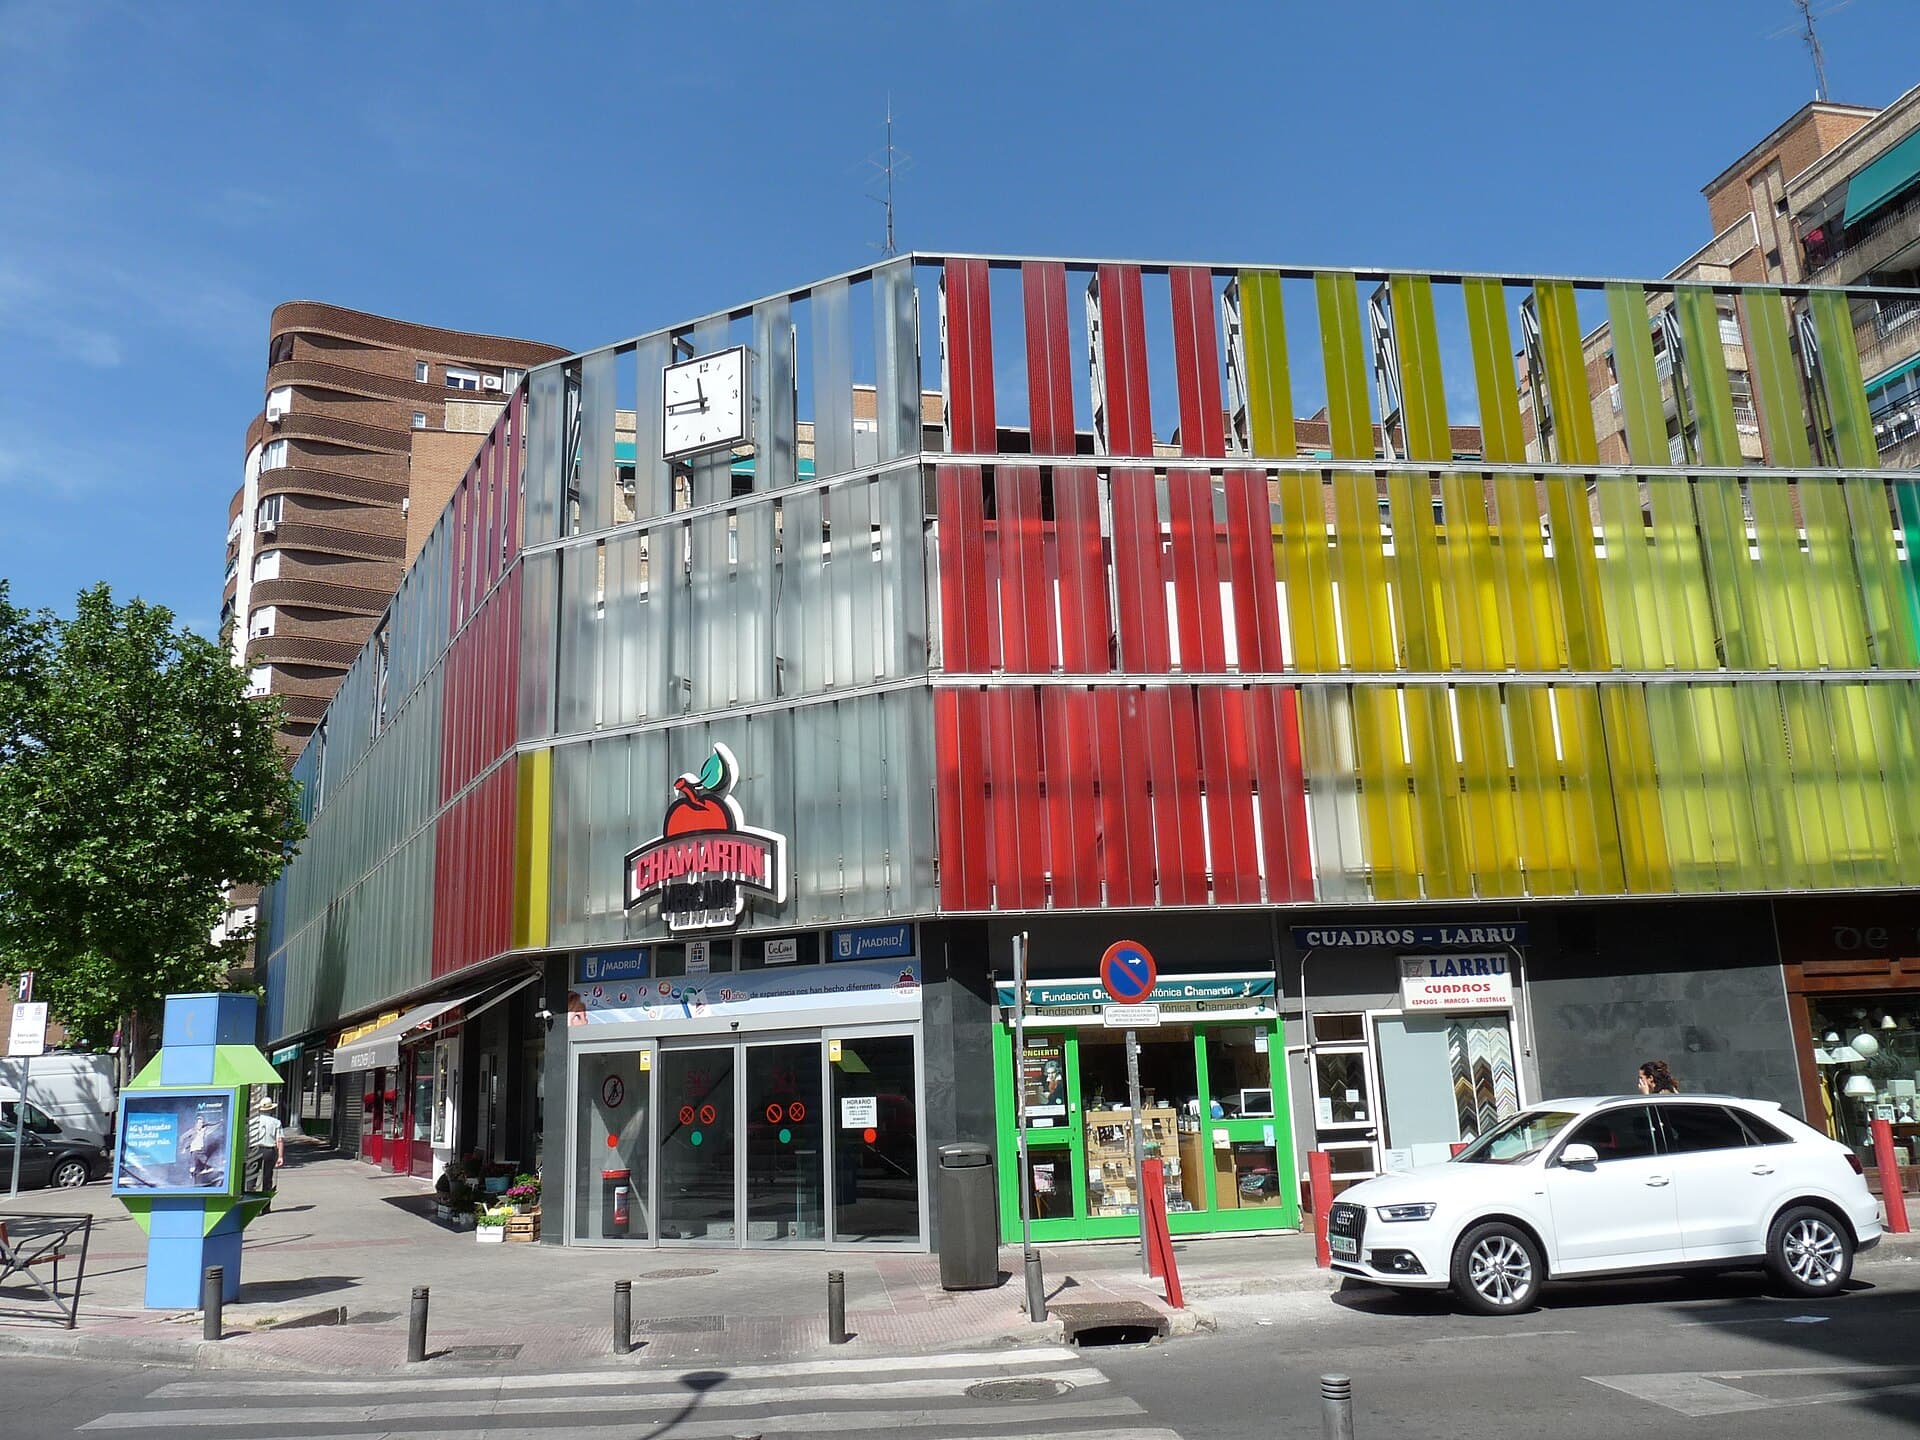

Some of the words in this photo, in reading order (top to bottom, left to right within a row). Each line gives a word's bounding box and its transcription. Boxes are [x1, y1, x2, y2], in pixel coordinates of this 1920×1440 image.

[700, 362, 709, 373] 12
[732, 389, 738, 399] 3
[700, 432, 706, 443] 6
[855, 928, 905, 955] ¡MADRID!
[1306, 929, 1415, 946] CUADROS
[1440, 927, 1516, 944] LARRU
[601, 953, 642, 976] ¡MADRID!
[1429, 957, 1505, 977] LARRU
[19, 976, 28, 998] P
[720, 988, 731, 1001] 50
[750, 991, 759, 999] de
[760, 989, 795, 999] experiencia
[810, 986, 822, 994] han
[824, 984, 845, 993] hecho
[846, 982, 881, 992] diferentes
[1042, 991, 1090, 1002] Fundación
[1184, 985, 1234, 996] Chamartín
[1425, 983, 1491, 994] CUADROS
[1023, 1049, 1059, 1057] ONCIERTO
